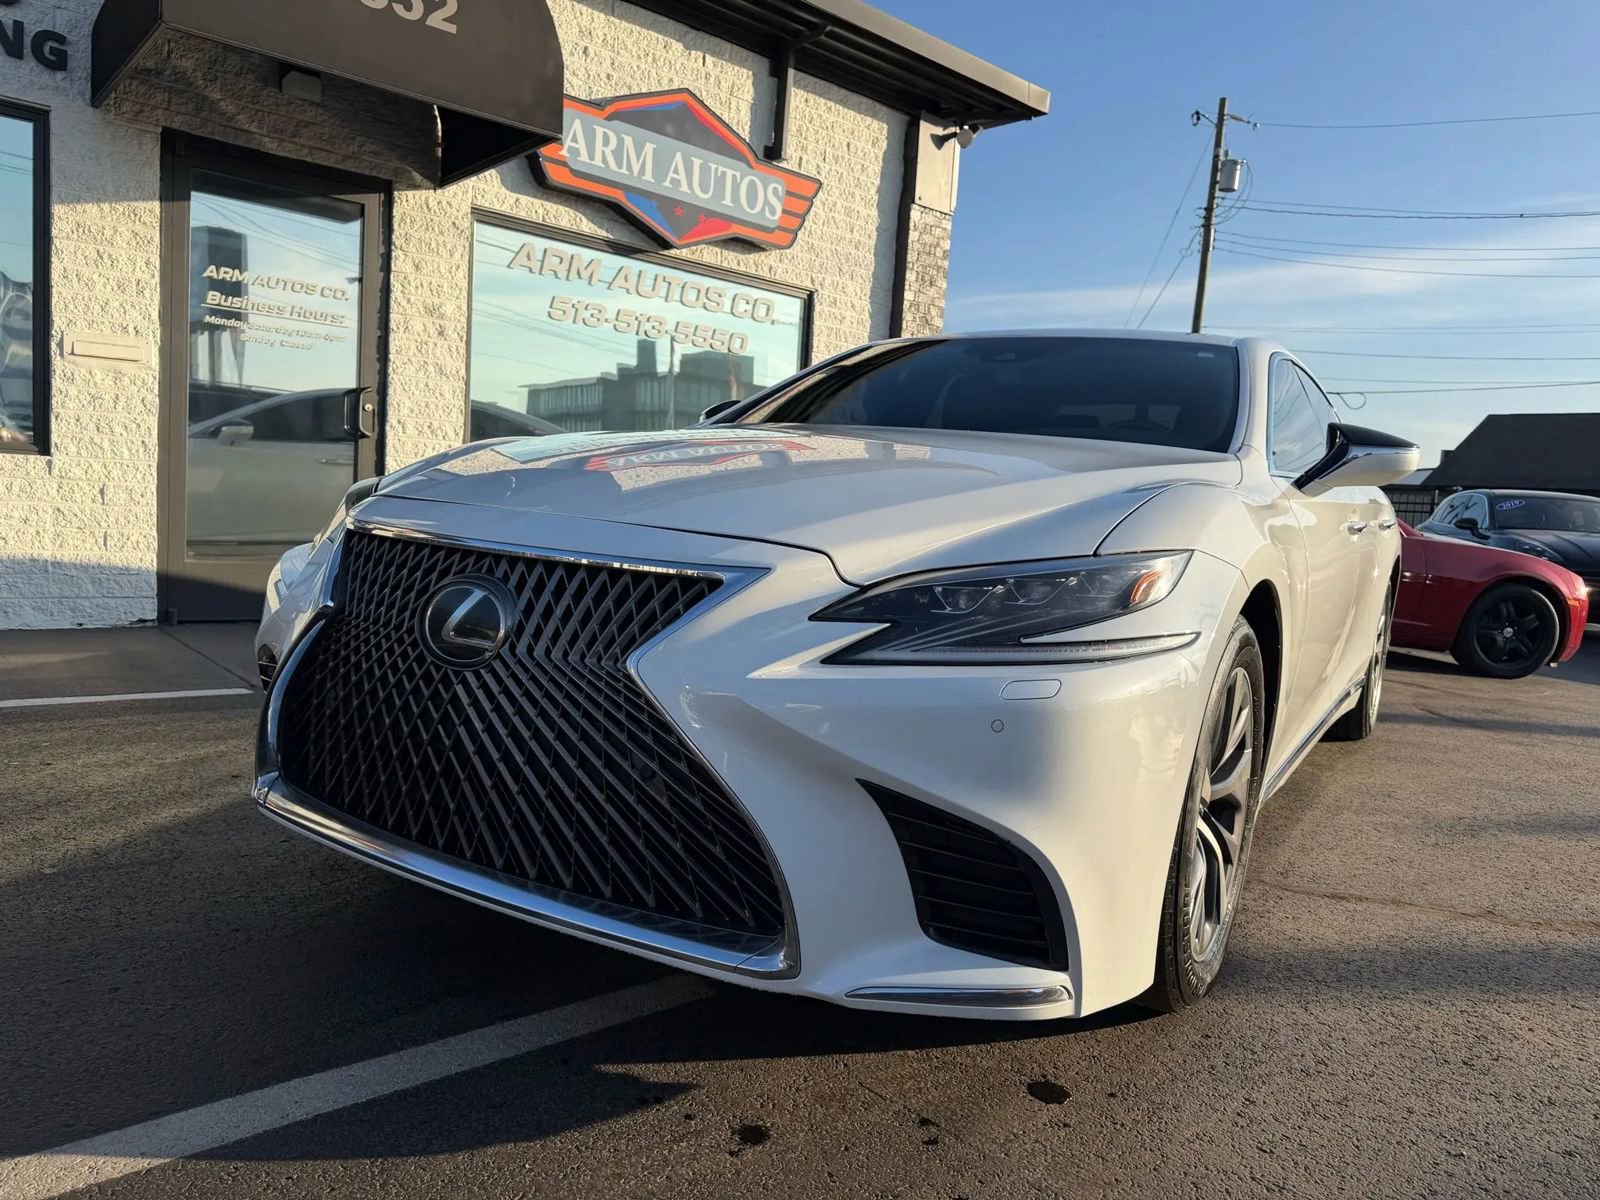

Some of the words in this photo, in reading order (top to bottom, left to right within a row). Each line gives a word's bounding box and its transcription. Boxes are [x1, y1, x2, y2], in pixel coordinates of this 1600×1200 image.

[559, 118, 656, 182] ARM
[663, 157, 785, 220] AUTOS
[202, 264, 249, 284] ARM
[251, 274, 317, 295] AUTOS
[206, 290, 286, 315] Business
[507, 242, 601, 286] ARM
[608, 266, 725, 312] AUTOS
[547, 294, 749, 355] 513-513-5550
